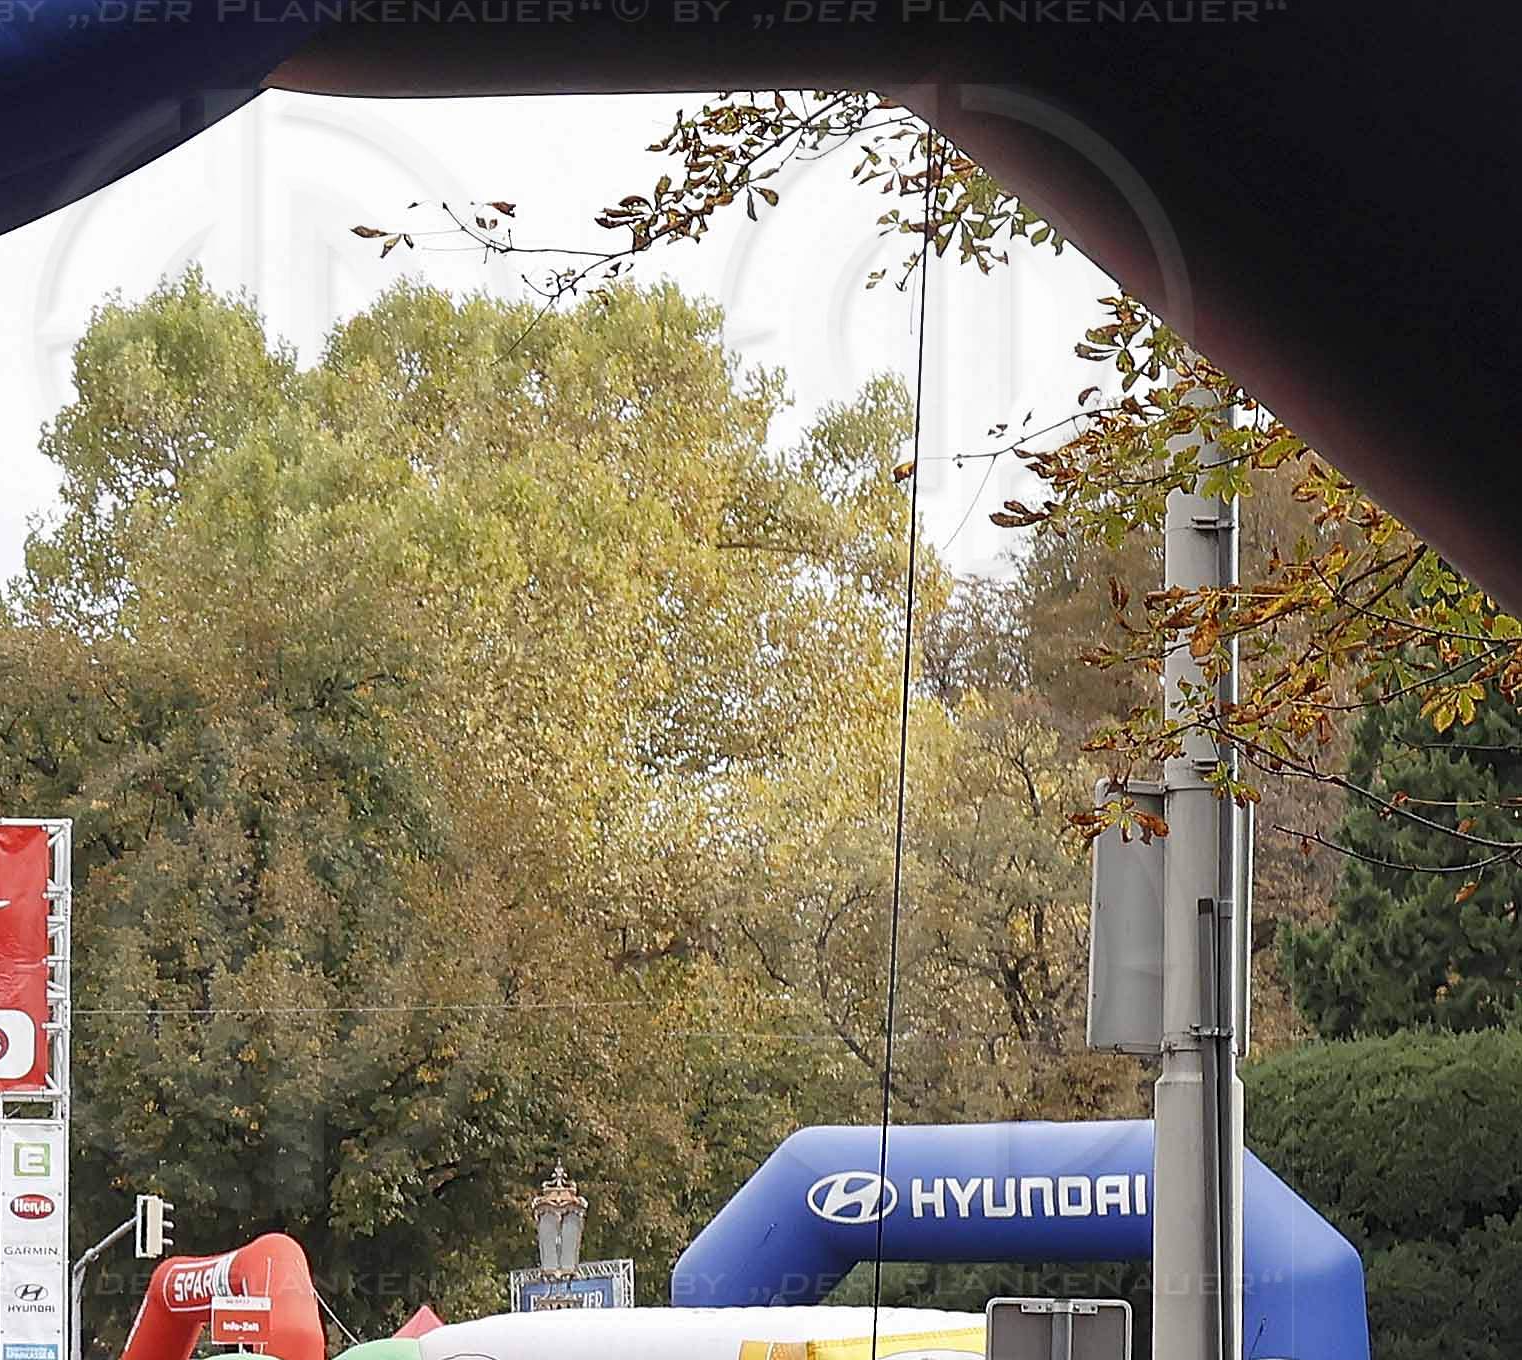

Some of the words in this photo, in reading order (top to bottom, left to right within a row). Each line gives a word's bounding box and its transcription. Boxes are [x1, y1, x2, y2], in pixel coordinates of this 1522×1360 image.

[911, 1174, 1146, 1219] HYUNDAI
[13, 1198, 54, 1215] Hervis
[8, 1305, 56, 1313] HYUNDAI
